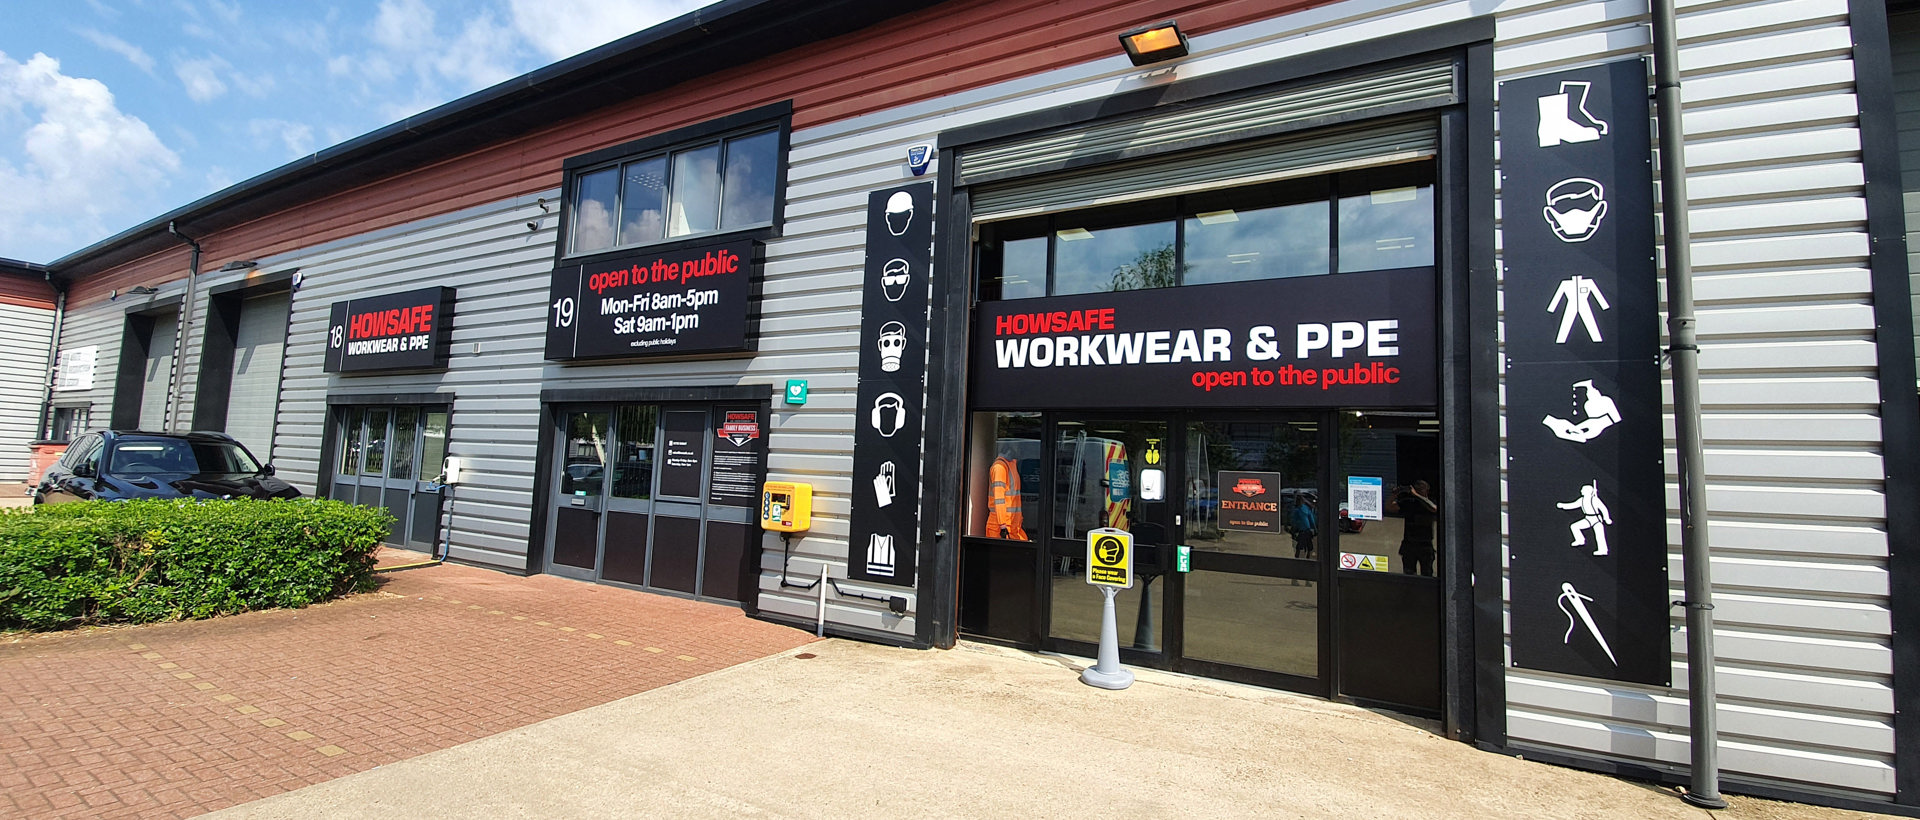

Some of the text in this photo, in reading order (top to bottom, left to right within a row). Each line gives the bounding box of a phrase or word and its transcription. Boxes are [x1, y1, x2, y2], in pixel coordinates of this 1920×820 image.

[588, 249, 739, 294] open to the public
[553, 297, 574, 328] 19
[601, 288, 719, 315] Mon-Fri 8am-5pm
[350, 305, 433, 338] HOWSAFE
[613, 312, 699, 335] Sat 9am-1pm
[995, 307, 1116, 336] HOWSAFE
[330, 325, 343, 349] 18
[348, 334, 430, 355] WORKWEAR & PPE
[995, 319, 1400, 369] WORKWEAR & PPE
[1191, 361, 1401, 392] open to the public
[1222, 500, 1277, 512] ENTRANCE
